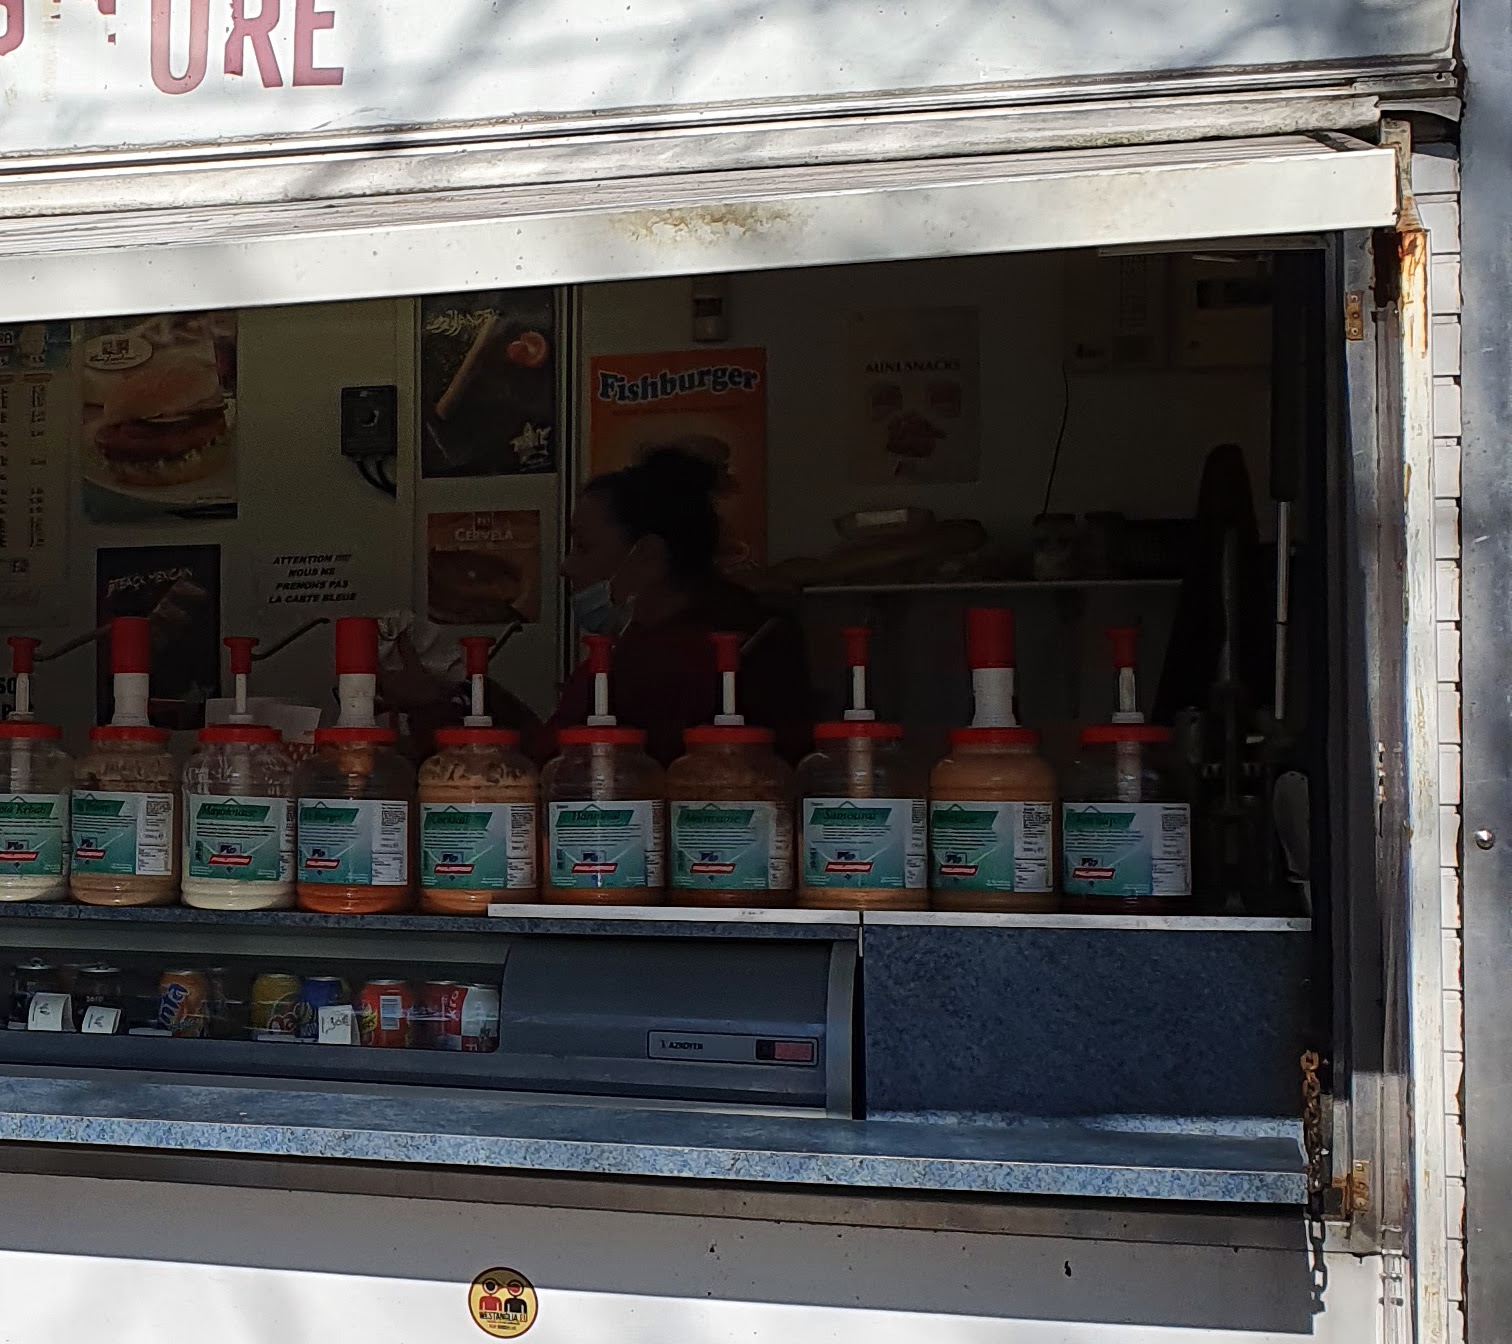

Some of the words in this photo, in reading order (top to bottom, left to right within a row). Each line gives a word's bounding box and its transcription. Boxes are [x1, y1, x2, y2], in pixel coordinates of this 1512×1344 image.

[598, 366, 760, 404] Fishburger
[273, 554, 333, 565] ATTENTION
[288, 568, 319, 577] NOUS
[320, 567, 336, 576] NE
[275, 580, 326, 590] PRENONS
[328, 579, 349, 589] PAS
[268, 596, 282, 604] LA
[284, 594, 320, 604] CARTE
[322, 592, 357, 602] BLEUE
